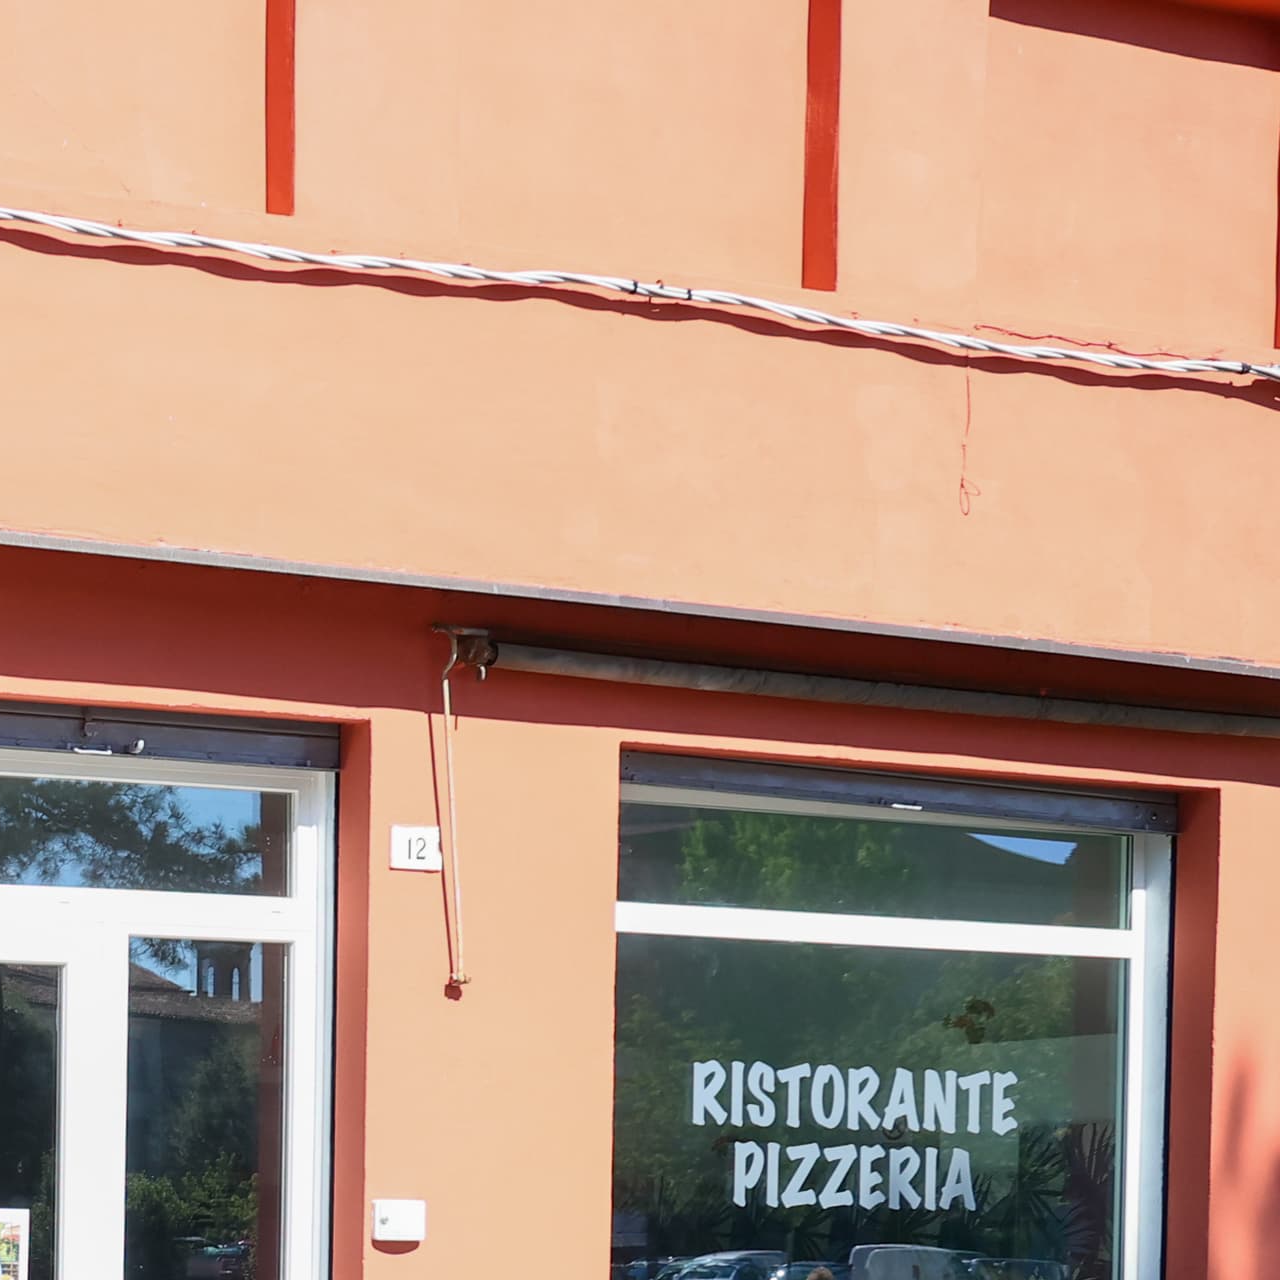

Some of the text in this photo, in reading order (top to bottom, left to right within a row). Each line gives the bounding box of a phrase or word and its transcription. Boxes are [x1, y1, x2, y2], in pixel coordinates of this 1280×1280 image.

[408, 837, 426, 860] 12
[692, 1060, 1018, 1136] RISTORANTE
[733, 1141, 976, 1211] PIZZERIA
